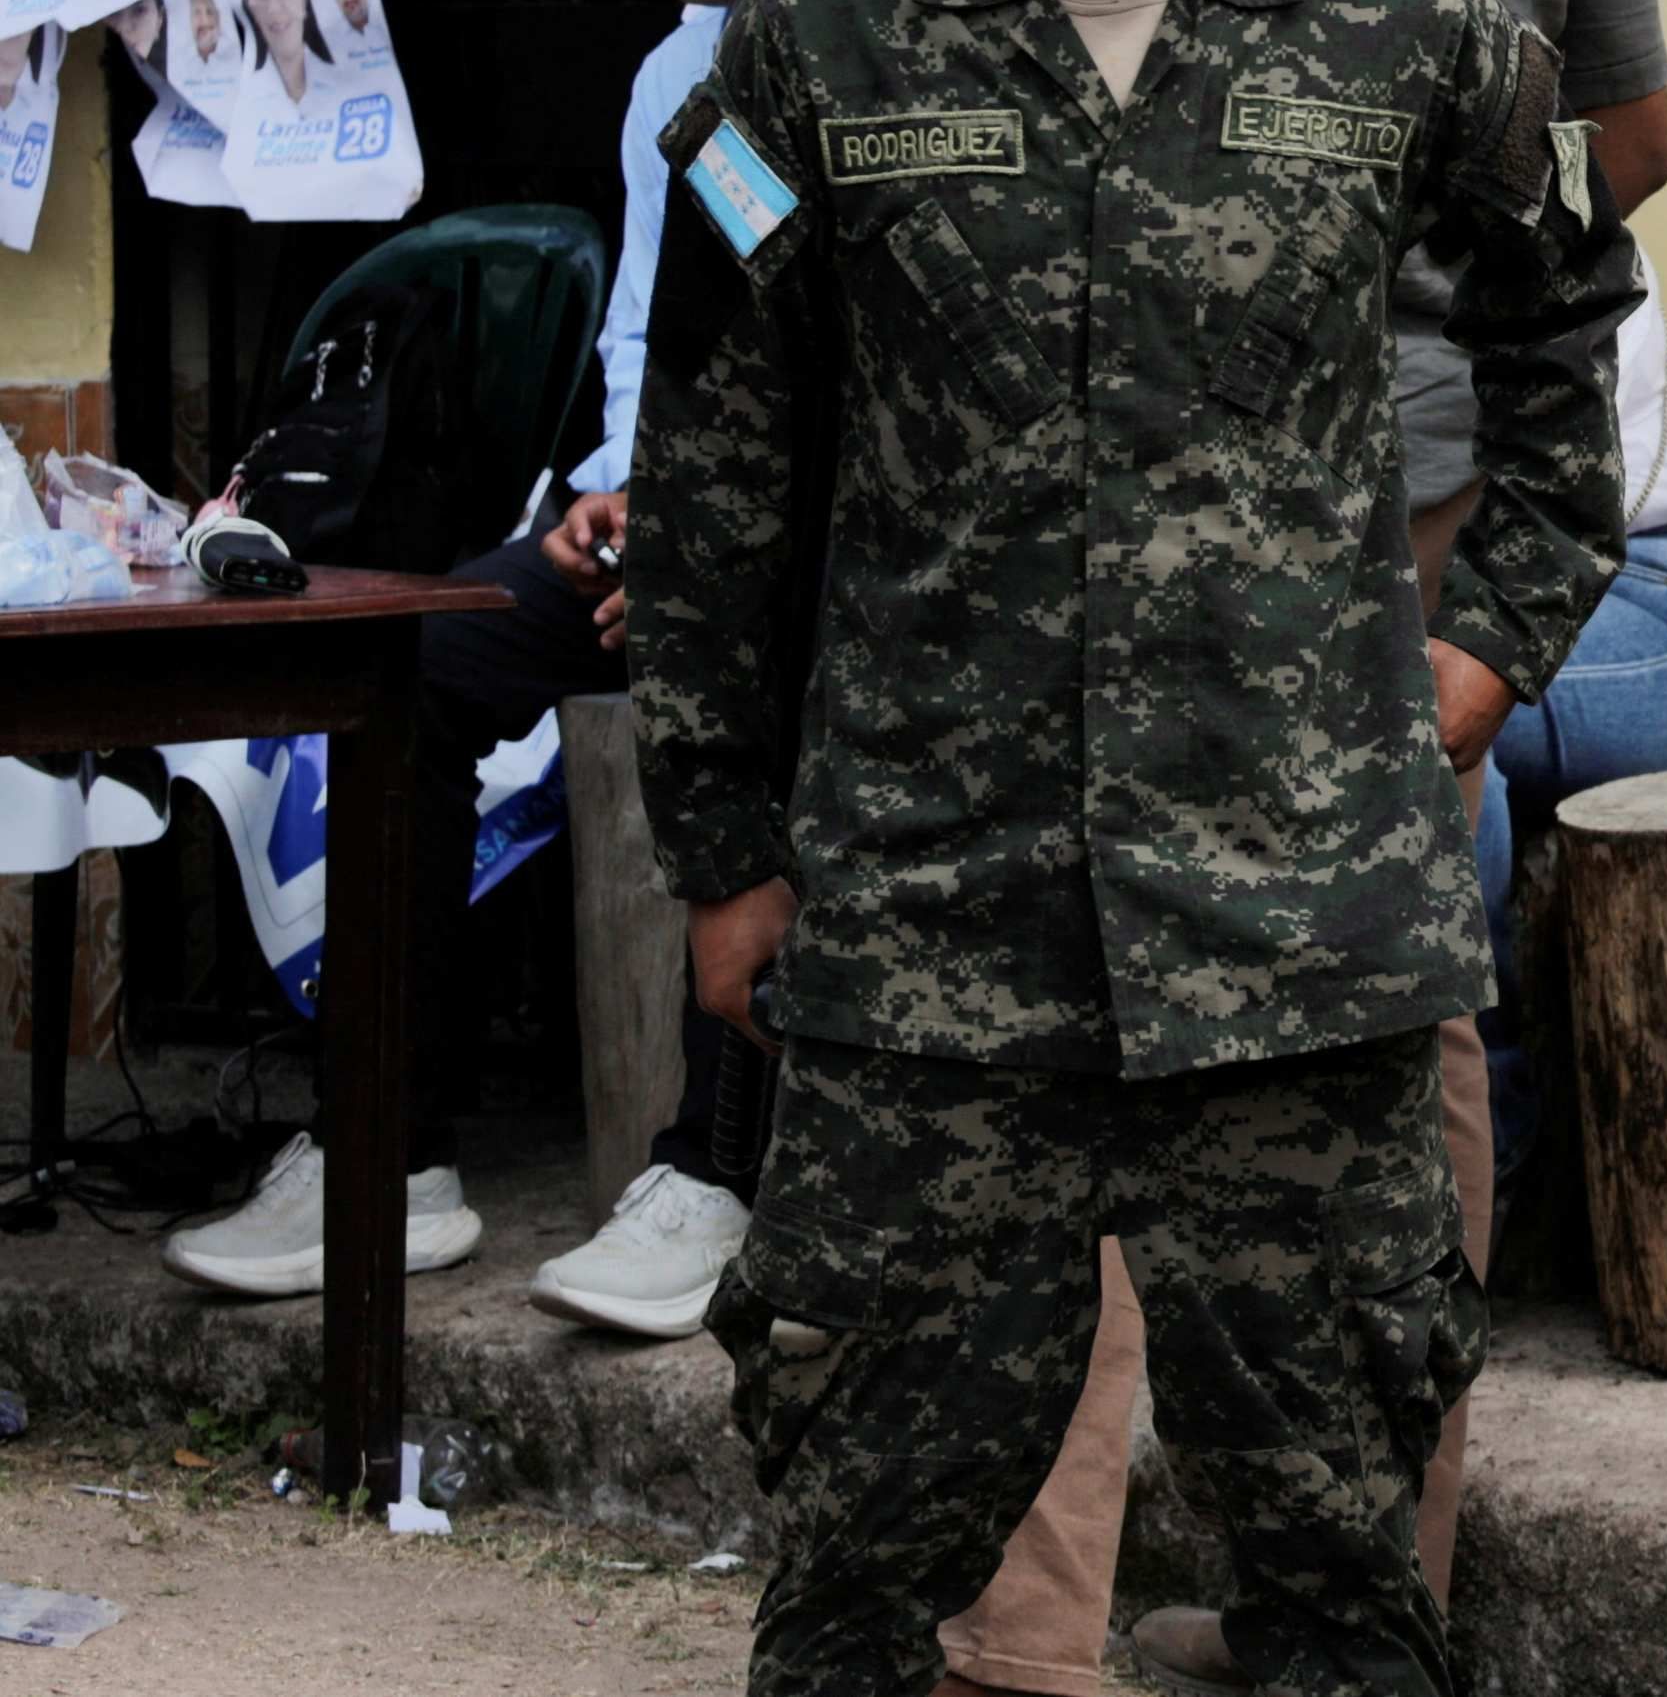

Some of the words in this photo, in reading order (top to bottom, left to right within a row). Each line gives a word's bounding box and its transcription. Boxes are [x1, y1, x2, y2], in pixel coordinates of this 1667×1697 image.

[343, 113, 385, 159] 28
[842, 125, 1007, 168] RODRIGUEZ
[1237, 104, 1403, 156] EJERCITO
